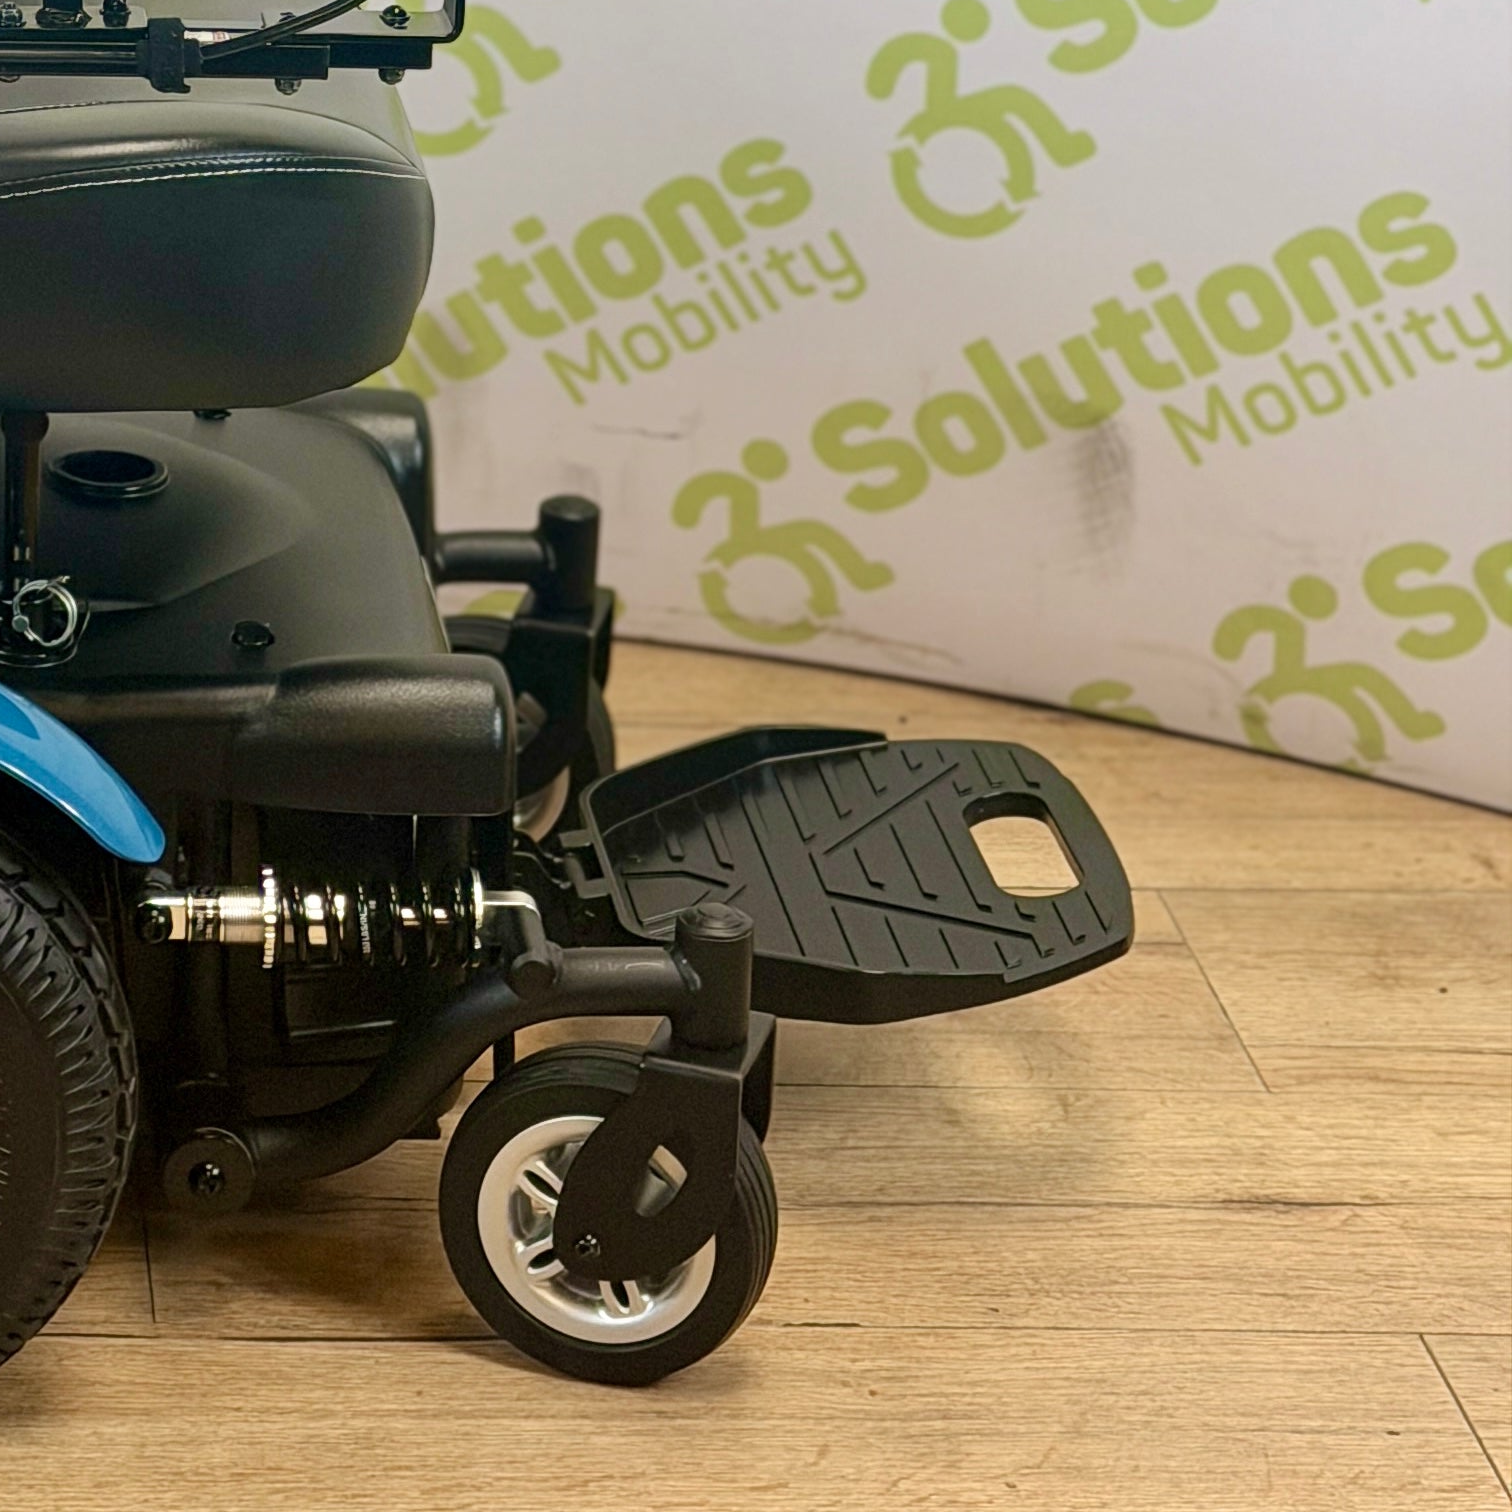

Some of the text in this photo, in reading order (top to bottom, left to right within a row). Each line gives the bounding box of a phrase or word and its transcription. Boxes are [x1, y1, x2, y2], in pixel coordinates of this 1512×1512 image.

[385, 136, 815, 407] utions
[540, 228, 870, 406] Mobility
[808, 189, 1460, 515] Solutions
[1157, 291, 1512, 467] Mobility
